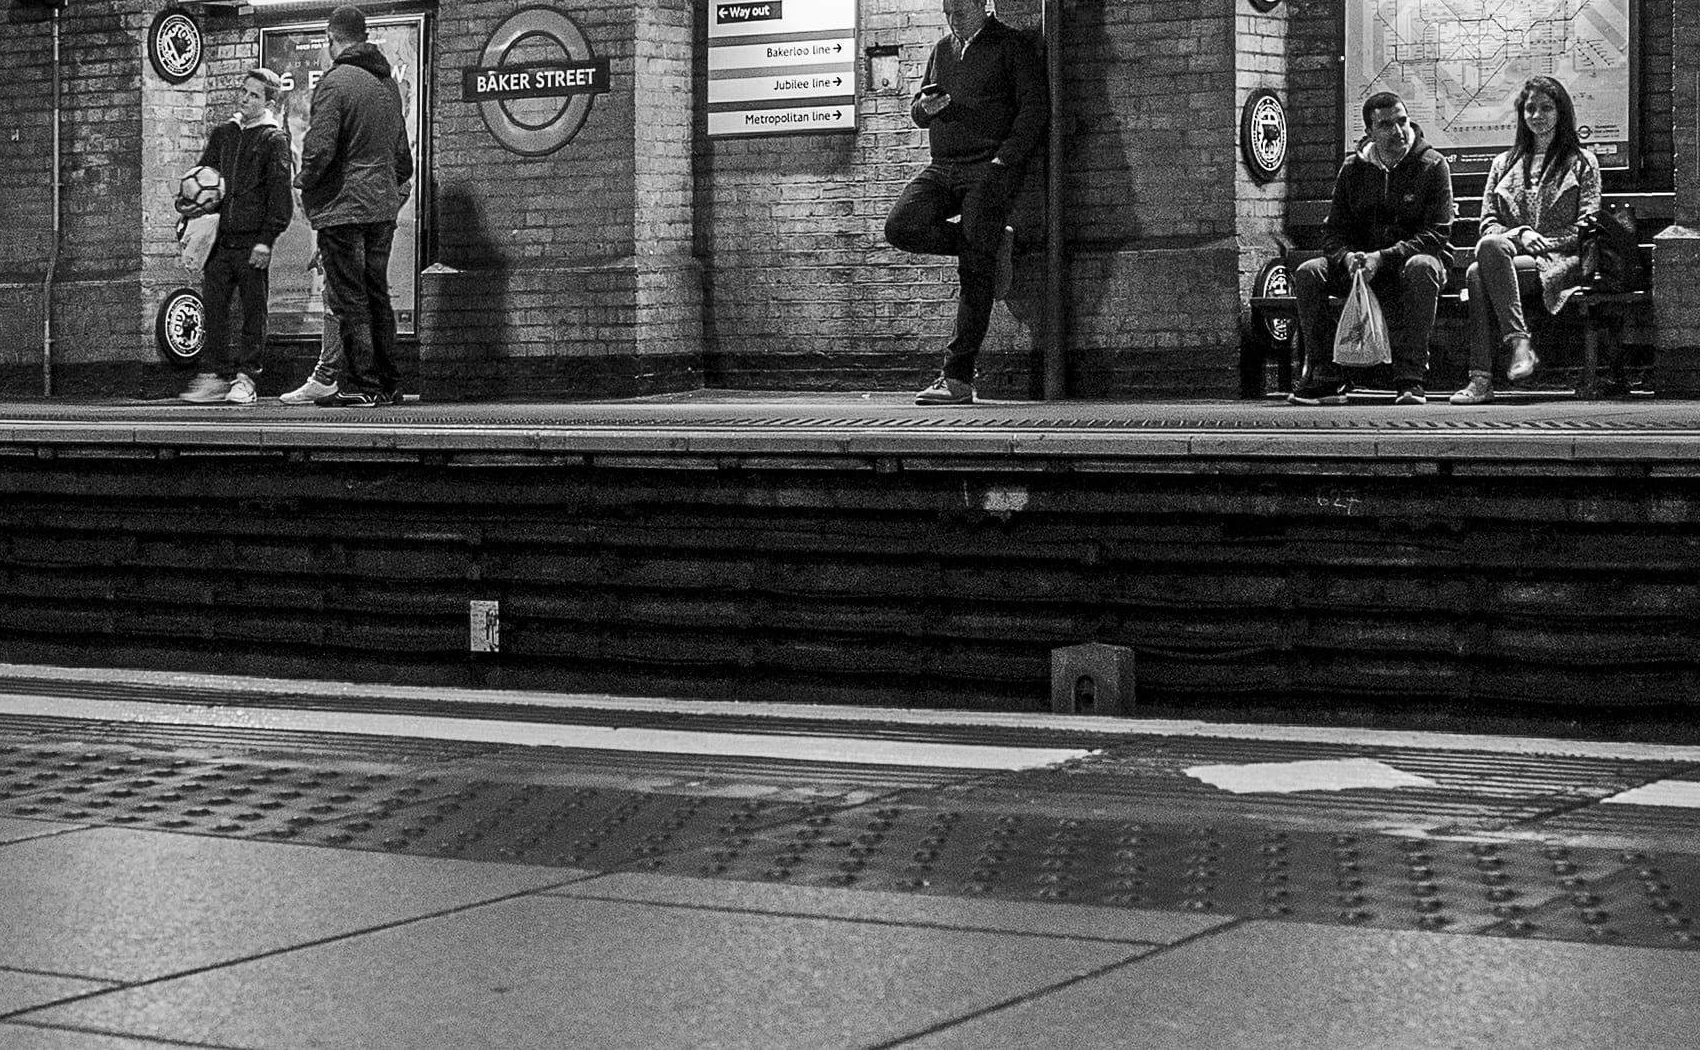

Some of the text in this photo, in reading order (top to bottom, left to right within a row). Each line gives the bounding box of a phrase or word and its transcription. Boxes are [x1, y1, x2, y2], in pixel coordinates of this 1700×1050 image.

[729, 5, 770, 19] Way out
[766, 44, 831, 58] Bakerloo line
[477, 68, 596, 93] BAKER STREET
[774, 77, 831, 91] Jubilee line
[745, 111, 831, 125] Metropolitan line
